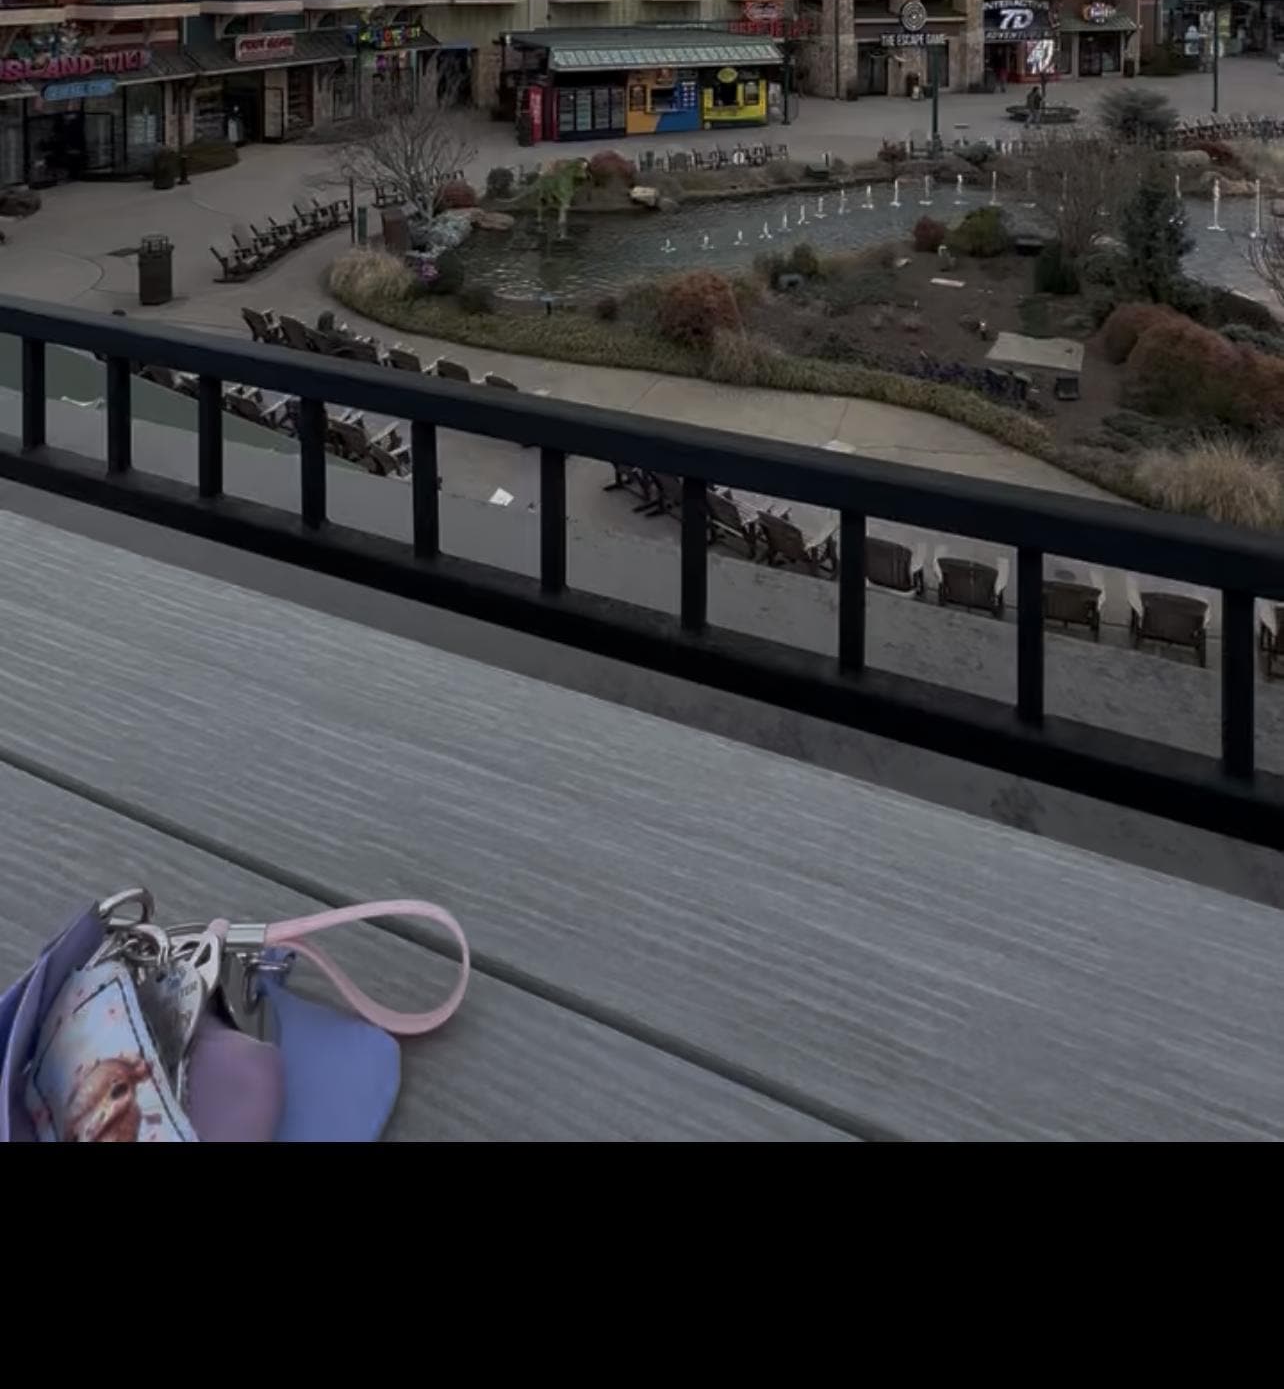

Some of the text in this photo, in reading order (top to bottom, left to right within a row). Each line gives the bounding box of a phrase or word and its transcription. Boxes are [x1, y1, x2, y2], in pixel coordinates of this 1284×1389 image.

[1000, 9, 1034, 30] 7D
[881, 35, 895, 45] THE
[896, 34, 924, 45] ESCAPE
